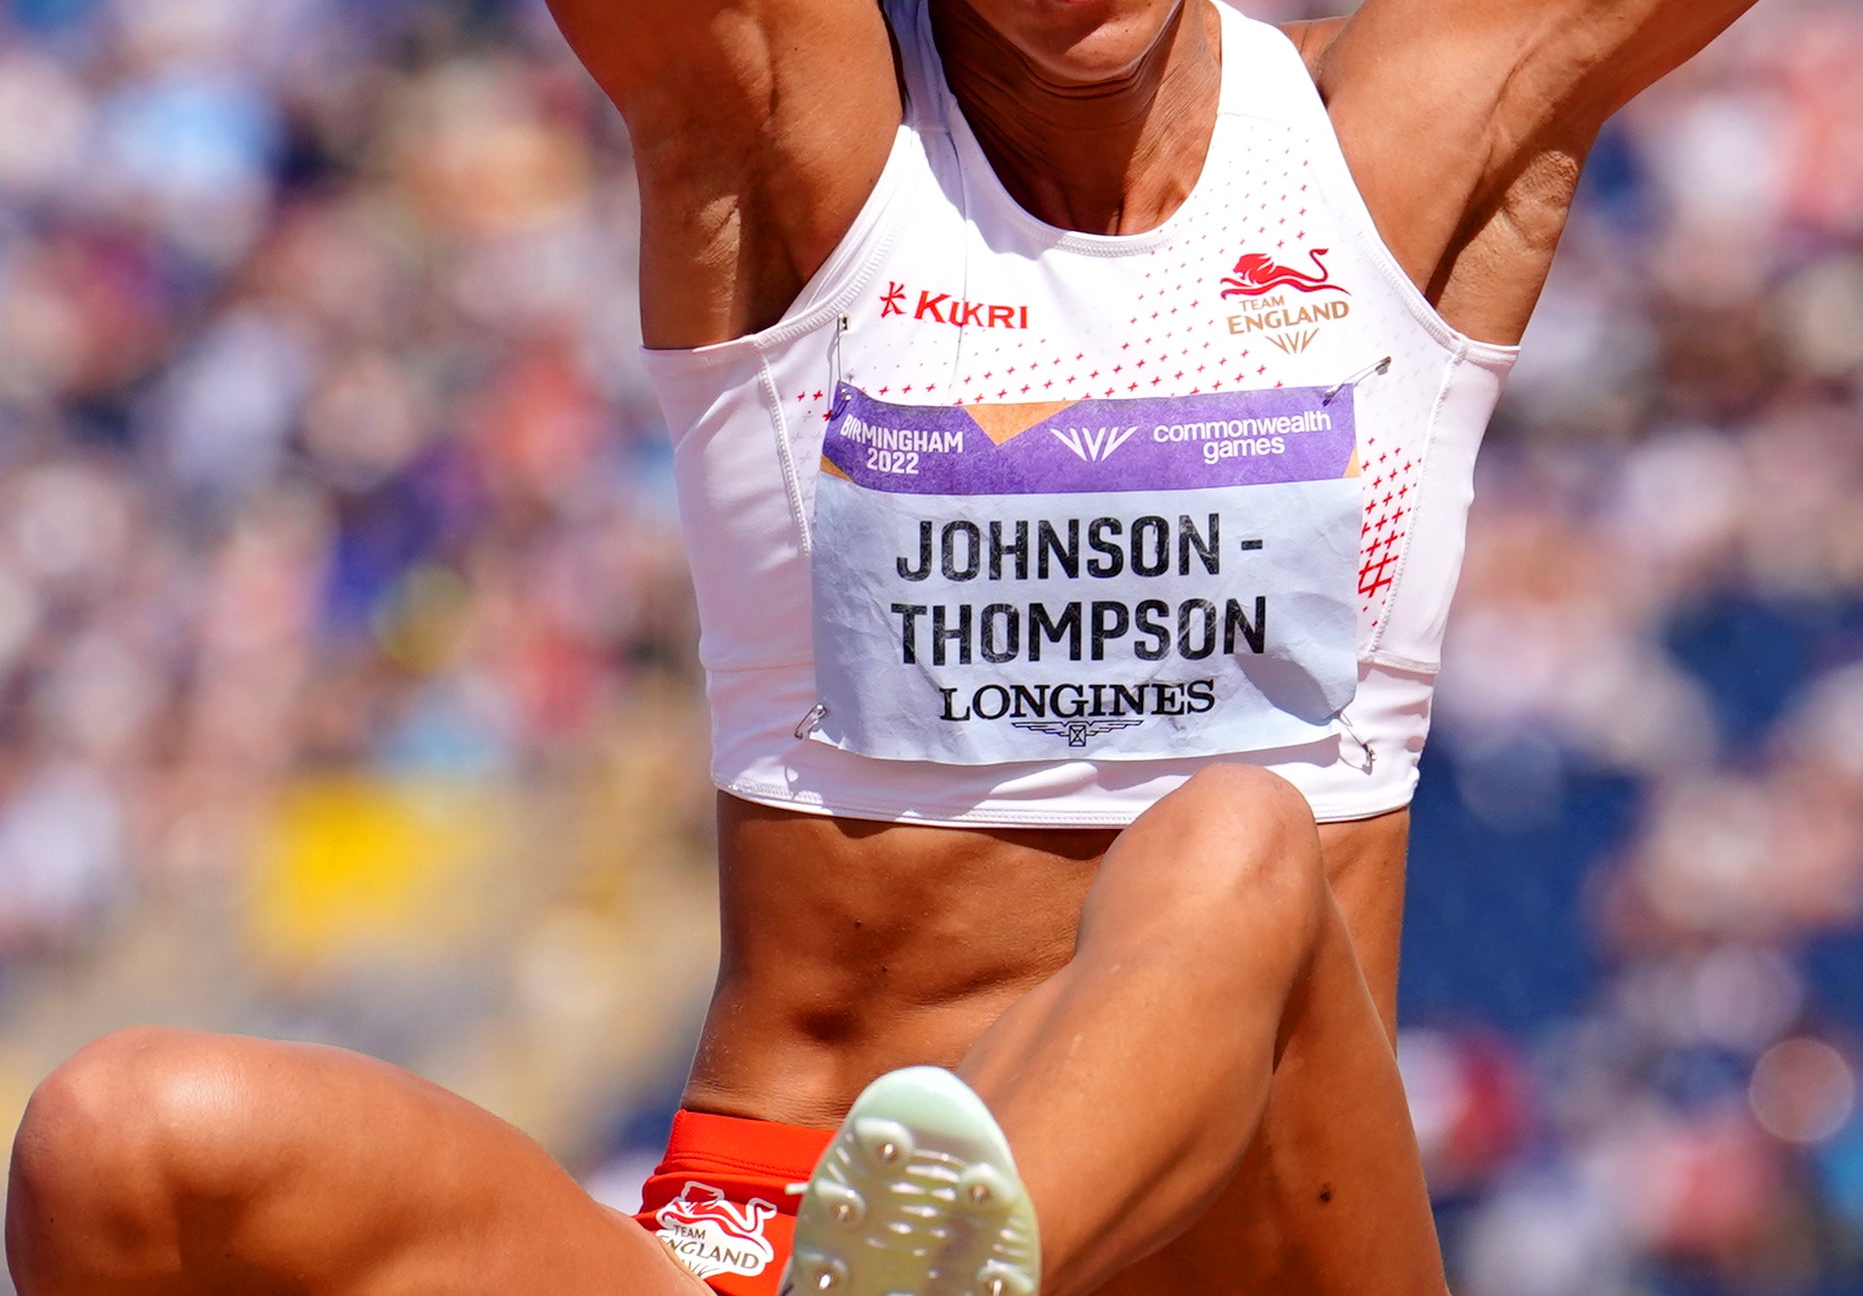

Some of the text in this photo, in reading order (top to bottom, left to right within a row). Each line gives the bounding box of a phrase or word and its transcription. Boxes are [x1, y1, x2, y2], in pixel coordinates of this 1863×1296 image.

[913, 290, 1030, 329] KUKRI
[1226, 300, 1351, 335] ENGLAND
[1238, 295, 1286, 313] TEAM
[839, 412, 964, 454] BIRMINGHAM
[1153, 410, 1333, 444] commonwealth
[865, 447, 920, 475] 2022
[1202, 432, 1286, 465] games
[896, 513, 1220, 582] JOHNSON
[891, 596, 1267, 666] THOMPSON
[939, 678, 1216, 721] LONGINES
[673, 1224, 706, 1240] TEAM
[660, 1234, 760, 1270] NGLAND
